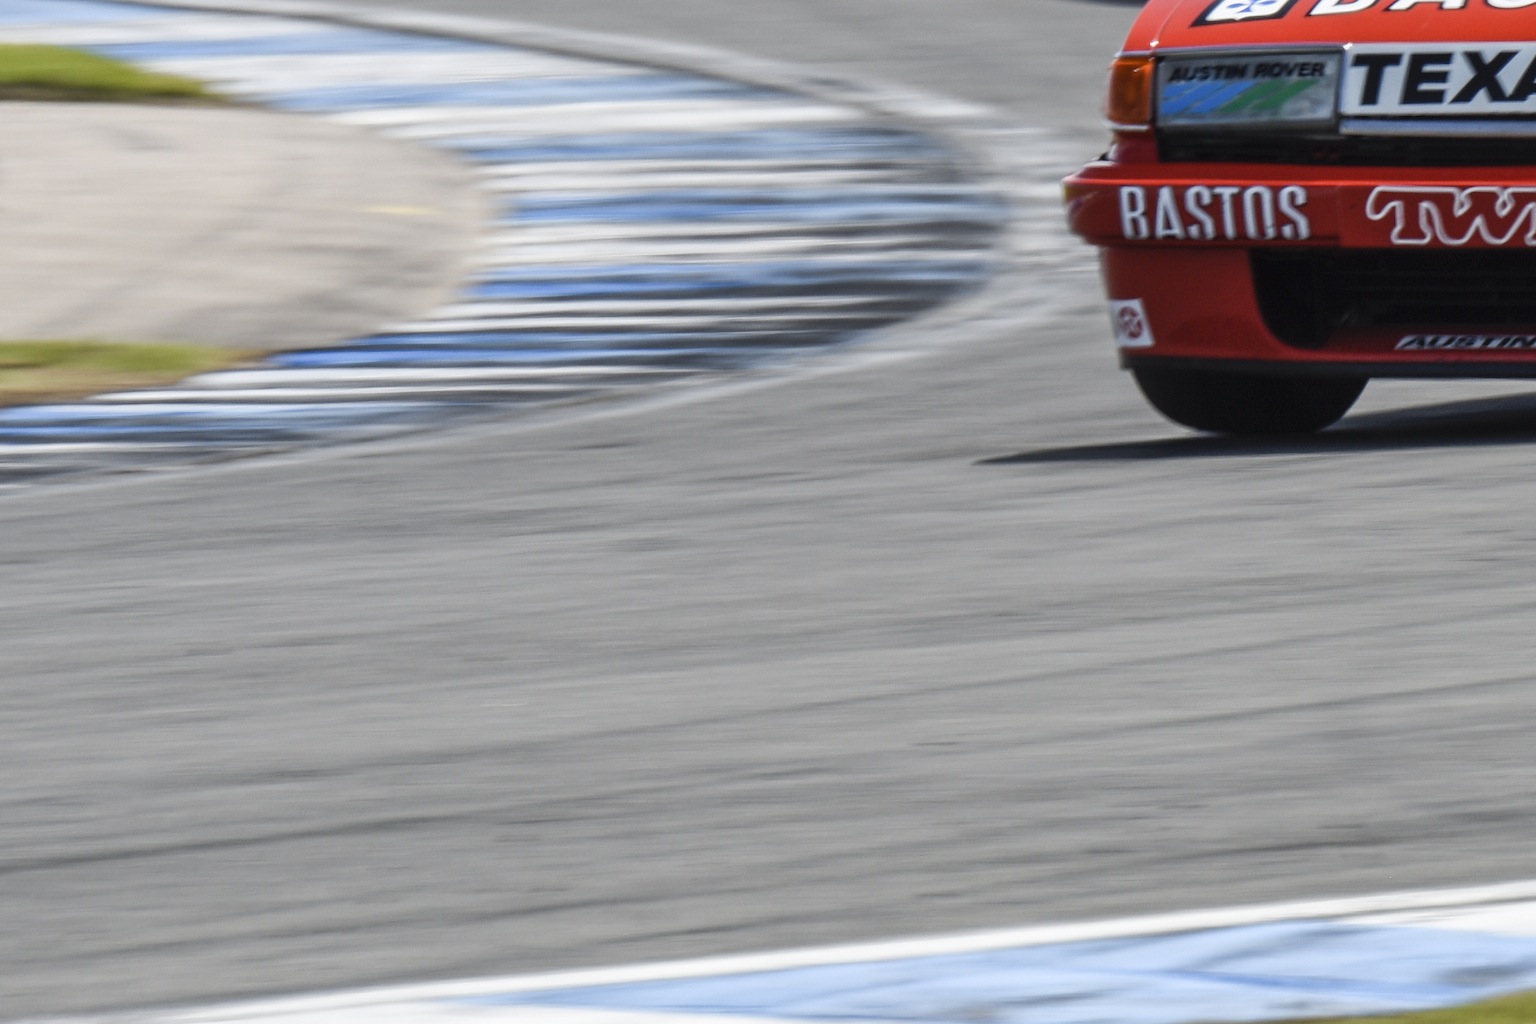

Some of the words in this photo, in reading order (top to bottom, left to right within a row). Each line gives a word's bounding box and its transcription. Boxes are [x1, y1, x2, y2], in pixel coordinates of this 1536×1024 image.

[1167, 63, 1249, 83] AUSTIN
[1254, 61, 1326, 79] ROVER
[1119, 184, 1311, 241] BASTOS
